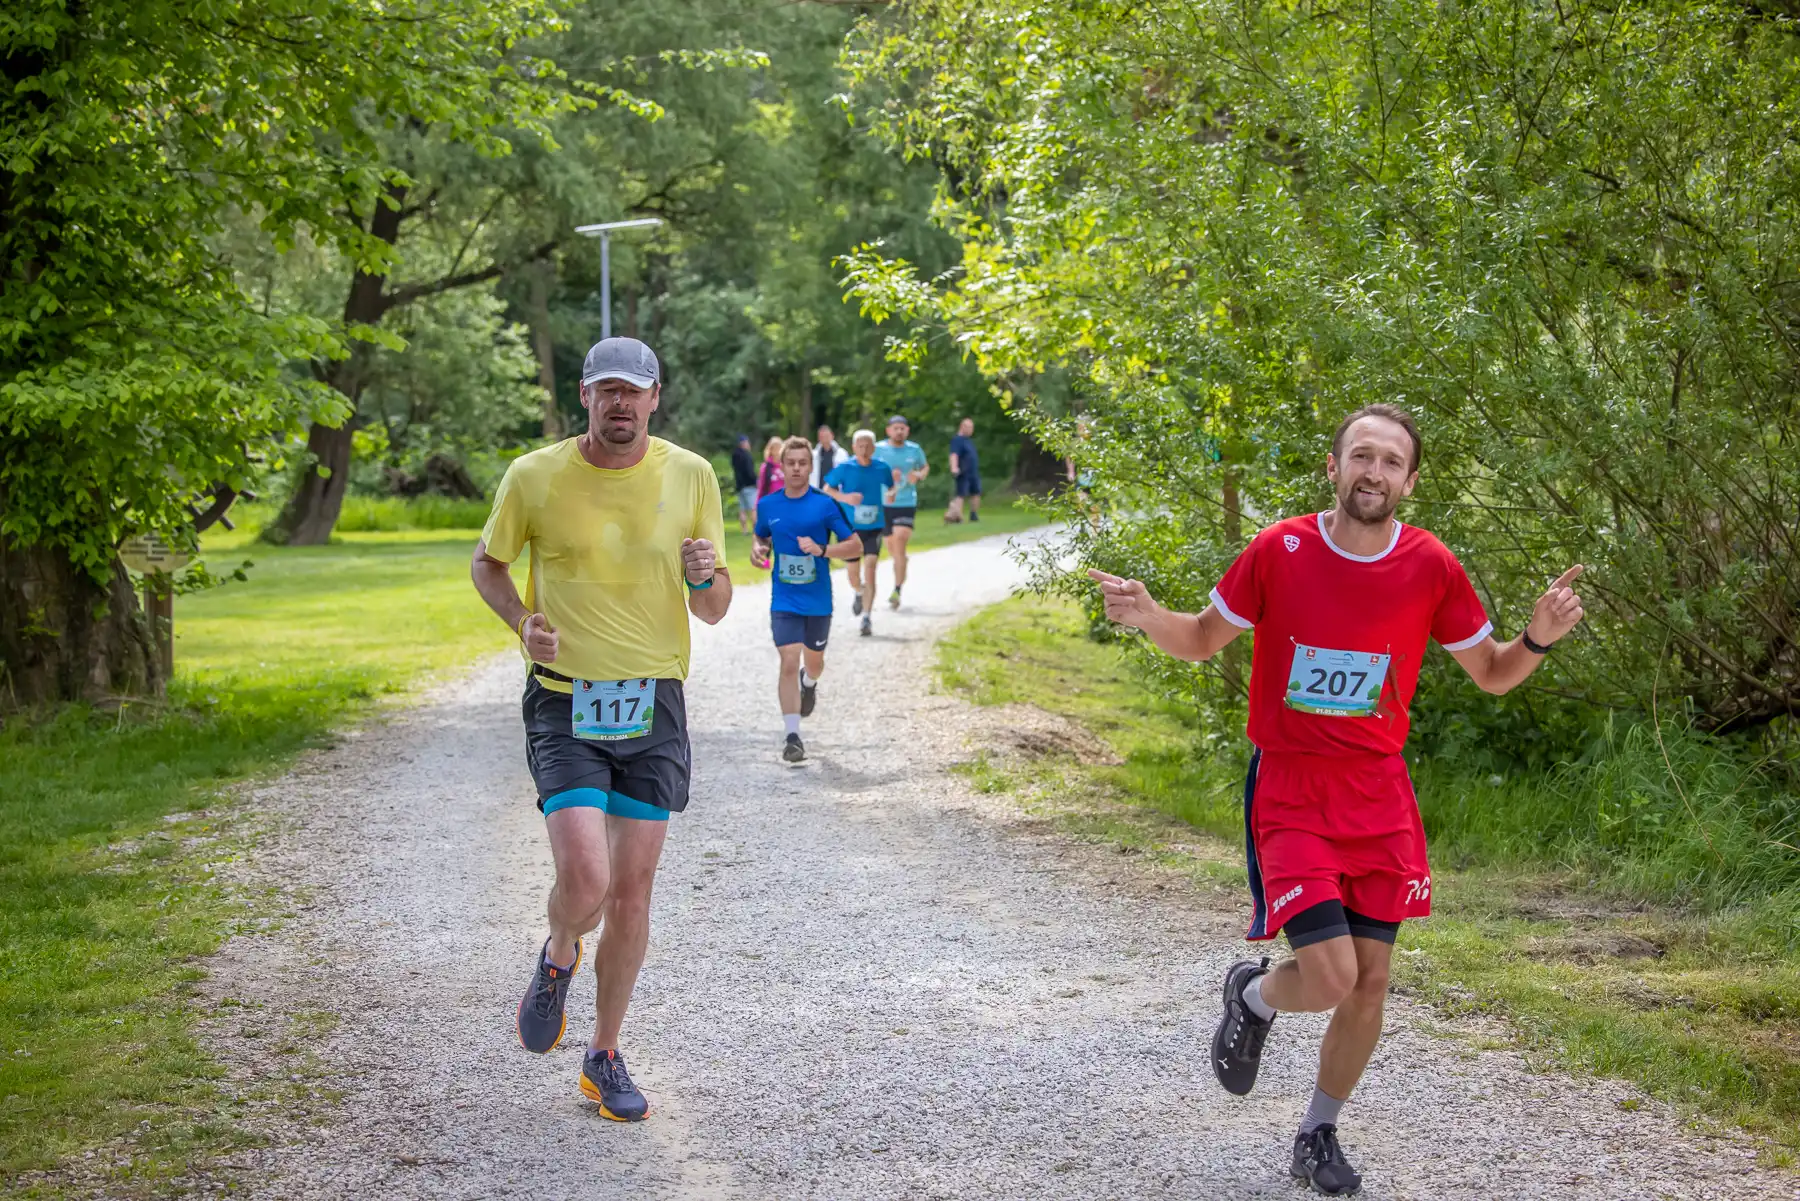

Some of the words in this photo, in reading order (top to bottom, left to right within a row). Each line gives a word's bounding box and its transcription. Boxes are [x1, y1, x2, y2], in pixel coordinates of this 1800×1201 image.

[788, 564, 805, 576] 85
[1306, 668, 1368, 697] 207
[590, 697, 641, 723] 117
